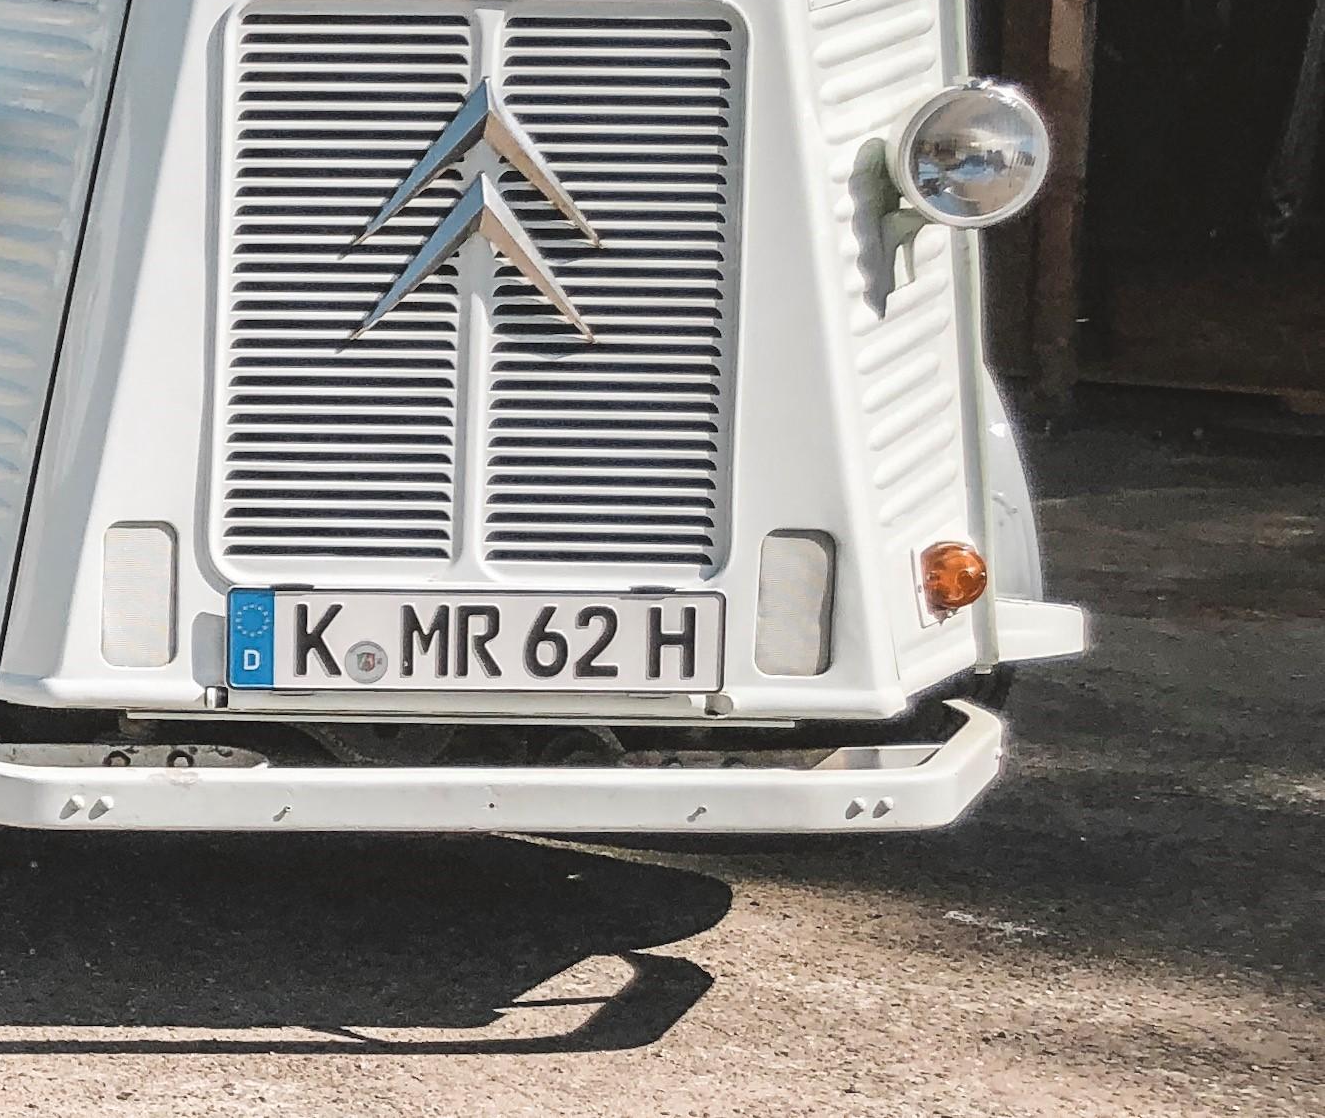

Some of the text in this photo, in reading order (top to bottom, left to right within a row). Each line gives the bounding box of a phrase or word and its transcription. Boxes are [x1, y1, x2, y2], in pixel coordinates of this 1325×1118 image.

[243, 603, 697, 680] D K MR 62 H
